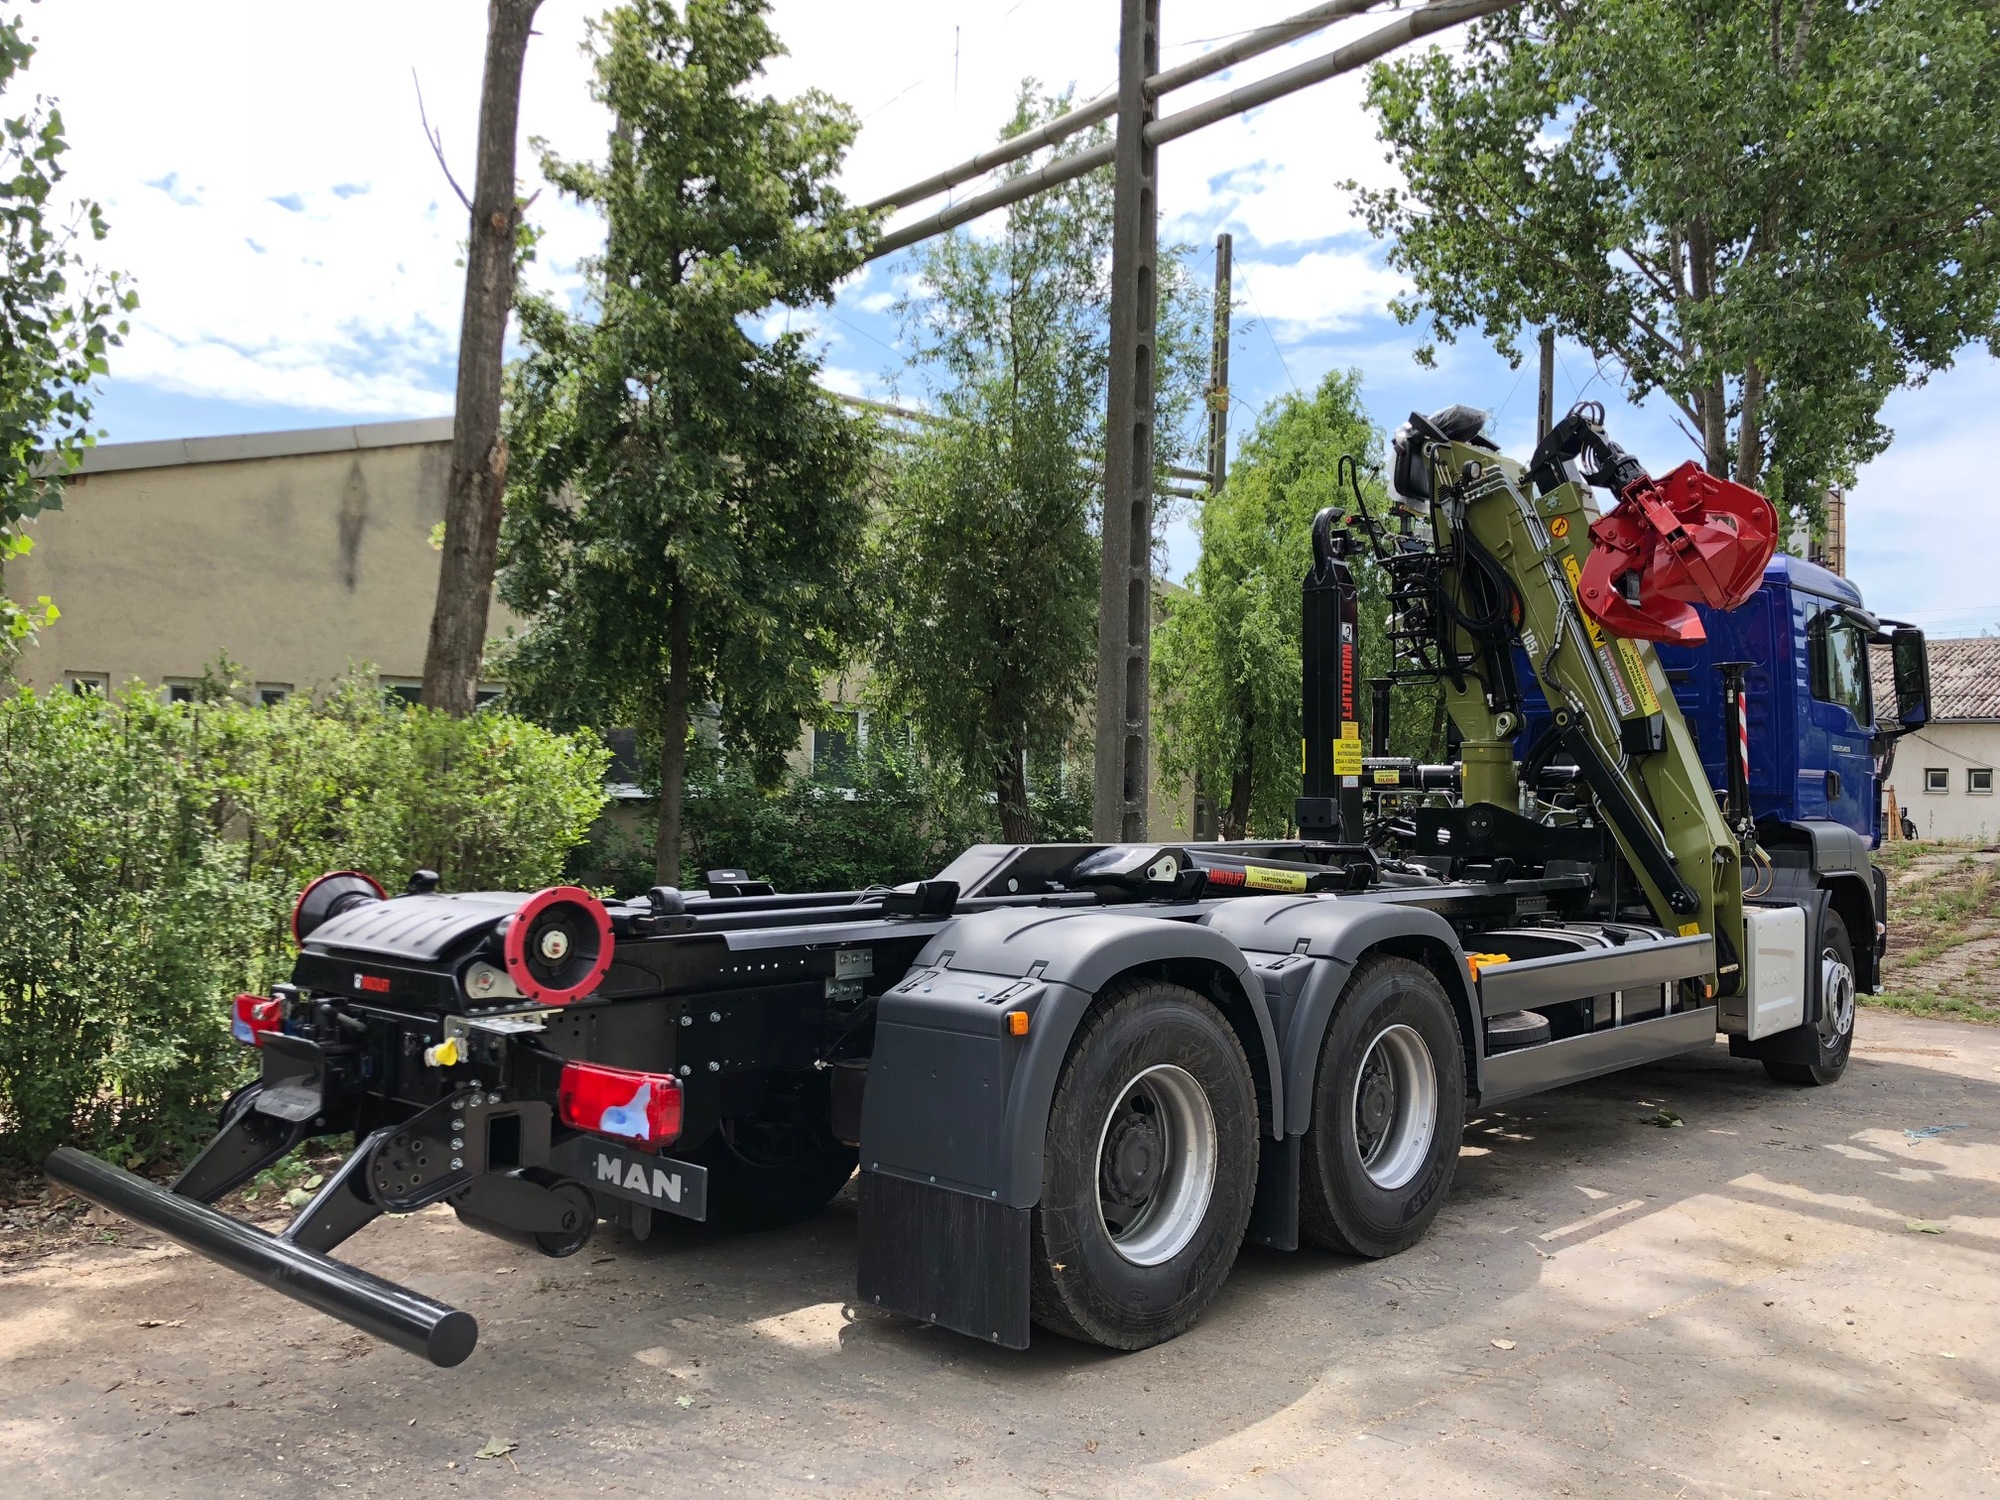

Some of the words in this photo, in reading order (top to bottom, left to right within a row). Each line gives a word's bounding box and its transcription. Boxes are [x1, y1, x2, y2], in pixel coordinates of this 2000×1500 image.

[1342, 643, 1352, 719] MULTILIFT
[1209, 868, 1246, 886] MULTILIFT
[598, 1153, 682, 1203] MAN
